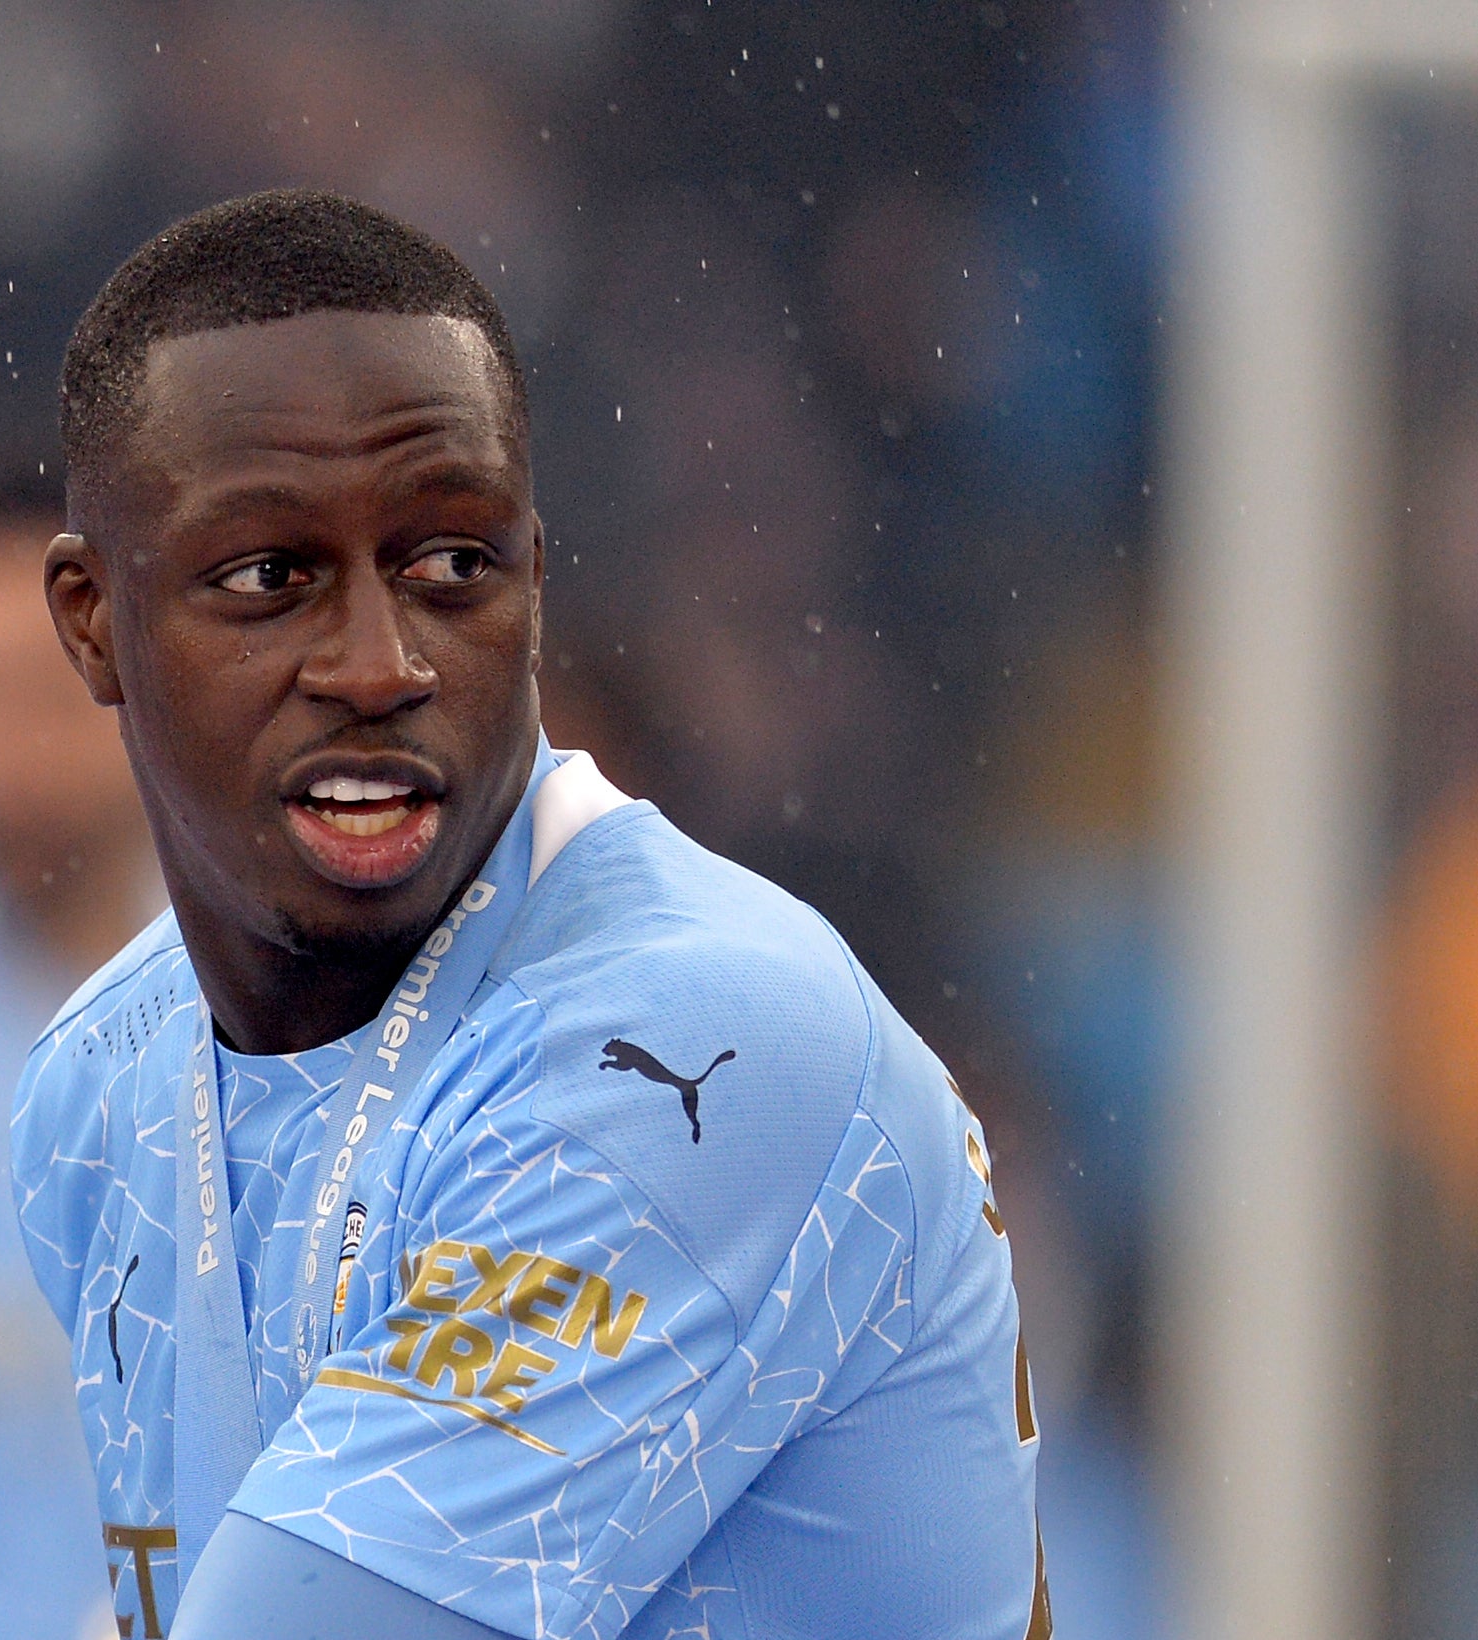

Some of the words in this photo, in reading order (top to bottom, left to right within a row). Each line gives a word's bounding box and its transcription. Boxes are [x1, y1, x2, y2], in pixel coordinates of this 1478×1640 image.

[376, 880, 497, 1073] Premier
[190, 1071, 219, 1276] Premier
[305, 1082, 395, 1285] League
